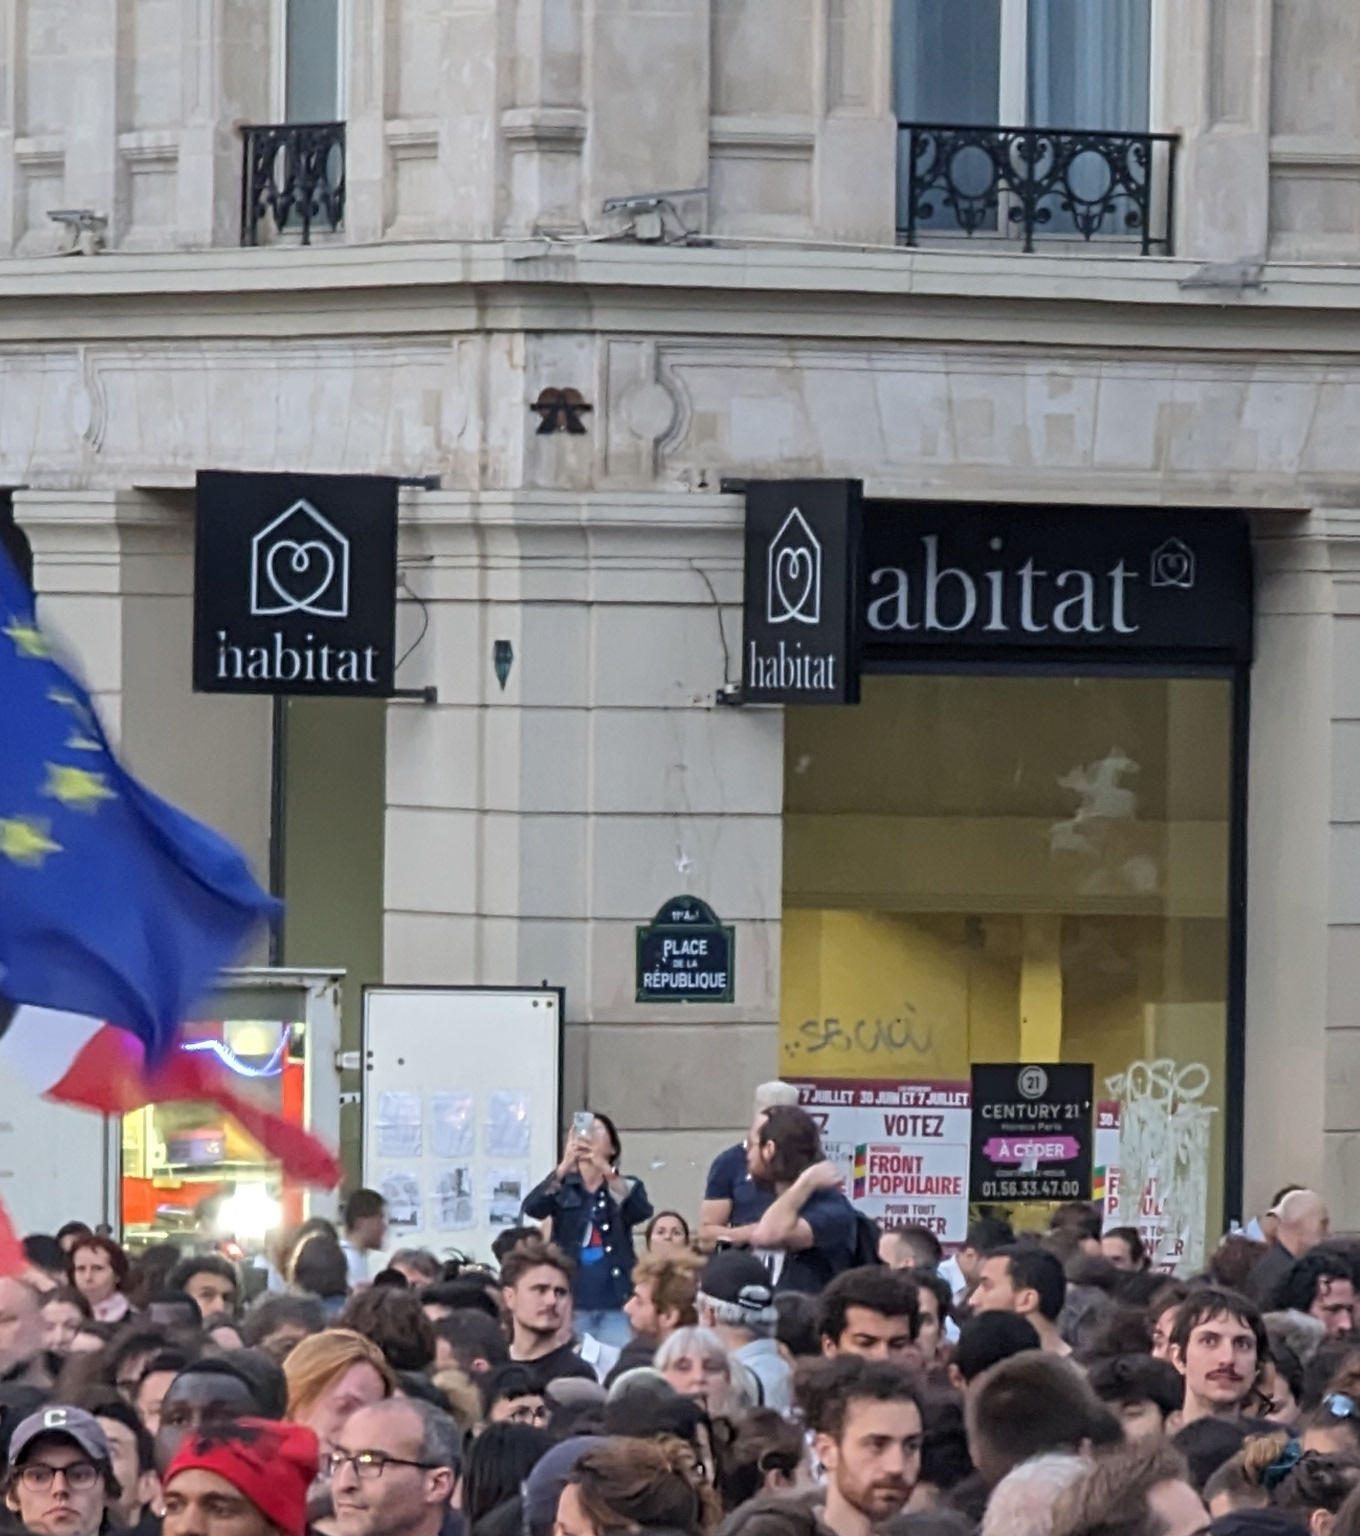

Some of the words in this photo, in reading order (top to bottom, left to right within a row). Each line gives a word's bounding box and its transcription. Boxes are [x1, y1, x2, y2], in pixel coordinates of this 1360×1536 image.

[867, 536, 1139, 634] abitat
[217, 630, 378, 683] habitat
[750, 641, 836, 690] habitat
[664, 939, 708, 956] PLACE
[673, 959, 684, 968] DE
[687, 959, 698, 968] LA
[644, 972, 726, 988] RÉPUBLIQUE
[1027, 1075, 1040, 1089] 21
[811, 1090, 854, 1104] JUILLET
[860, 1091, 874, 1104] 30
[875, 1092, 900, 1105] JUIN
[902, 1093, 915, 1106] ET
[918, 1093, 926, 1106] 7
[926, 1092, 969, 1106] JUILLET
[982, 1104, 1060, 1119] CENTURY
[1064, 1104, 1079, 1118] 21
[884, 1114, 945, 1138] VOTEZ
[1000, 1138, 1010, 1157] À
[1013, 1138, 1064, 1157] CÉDER
[869, 1155, 923, 1174] FRONT
[869, 1175, 962, 1195] POPULAIRE
[982, 1181, 1080, 1197] 01.56.33.47.00
[885, 1204, 909, 1215] POUR
[913, 1204, 936, 1215] TOUT
[44, 1409, 66, 1427] C
